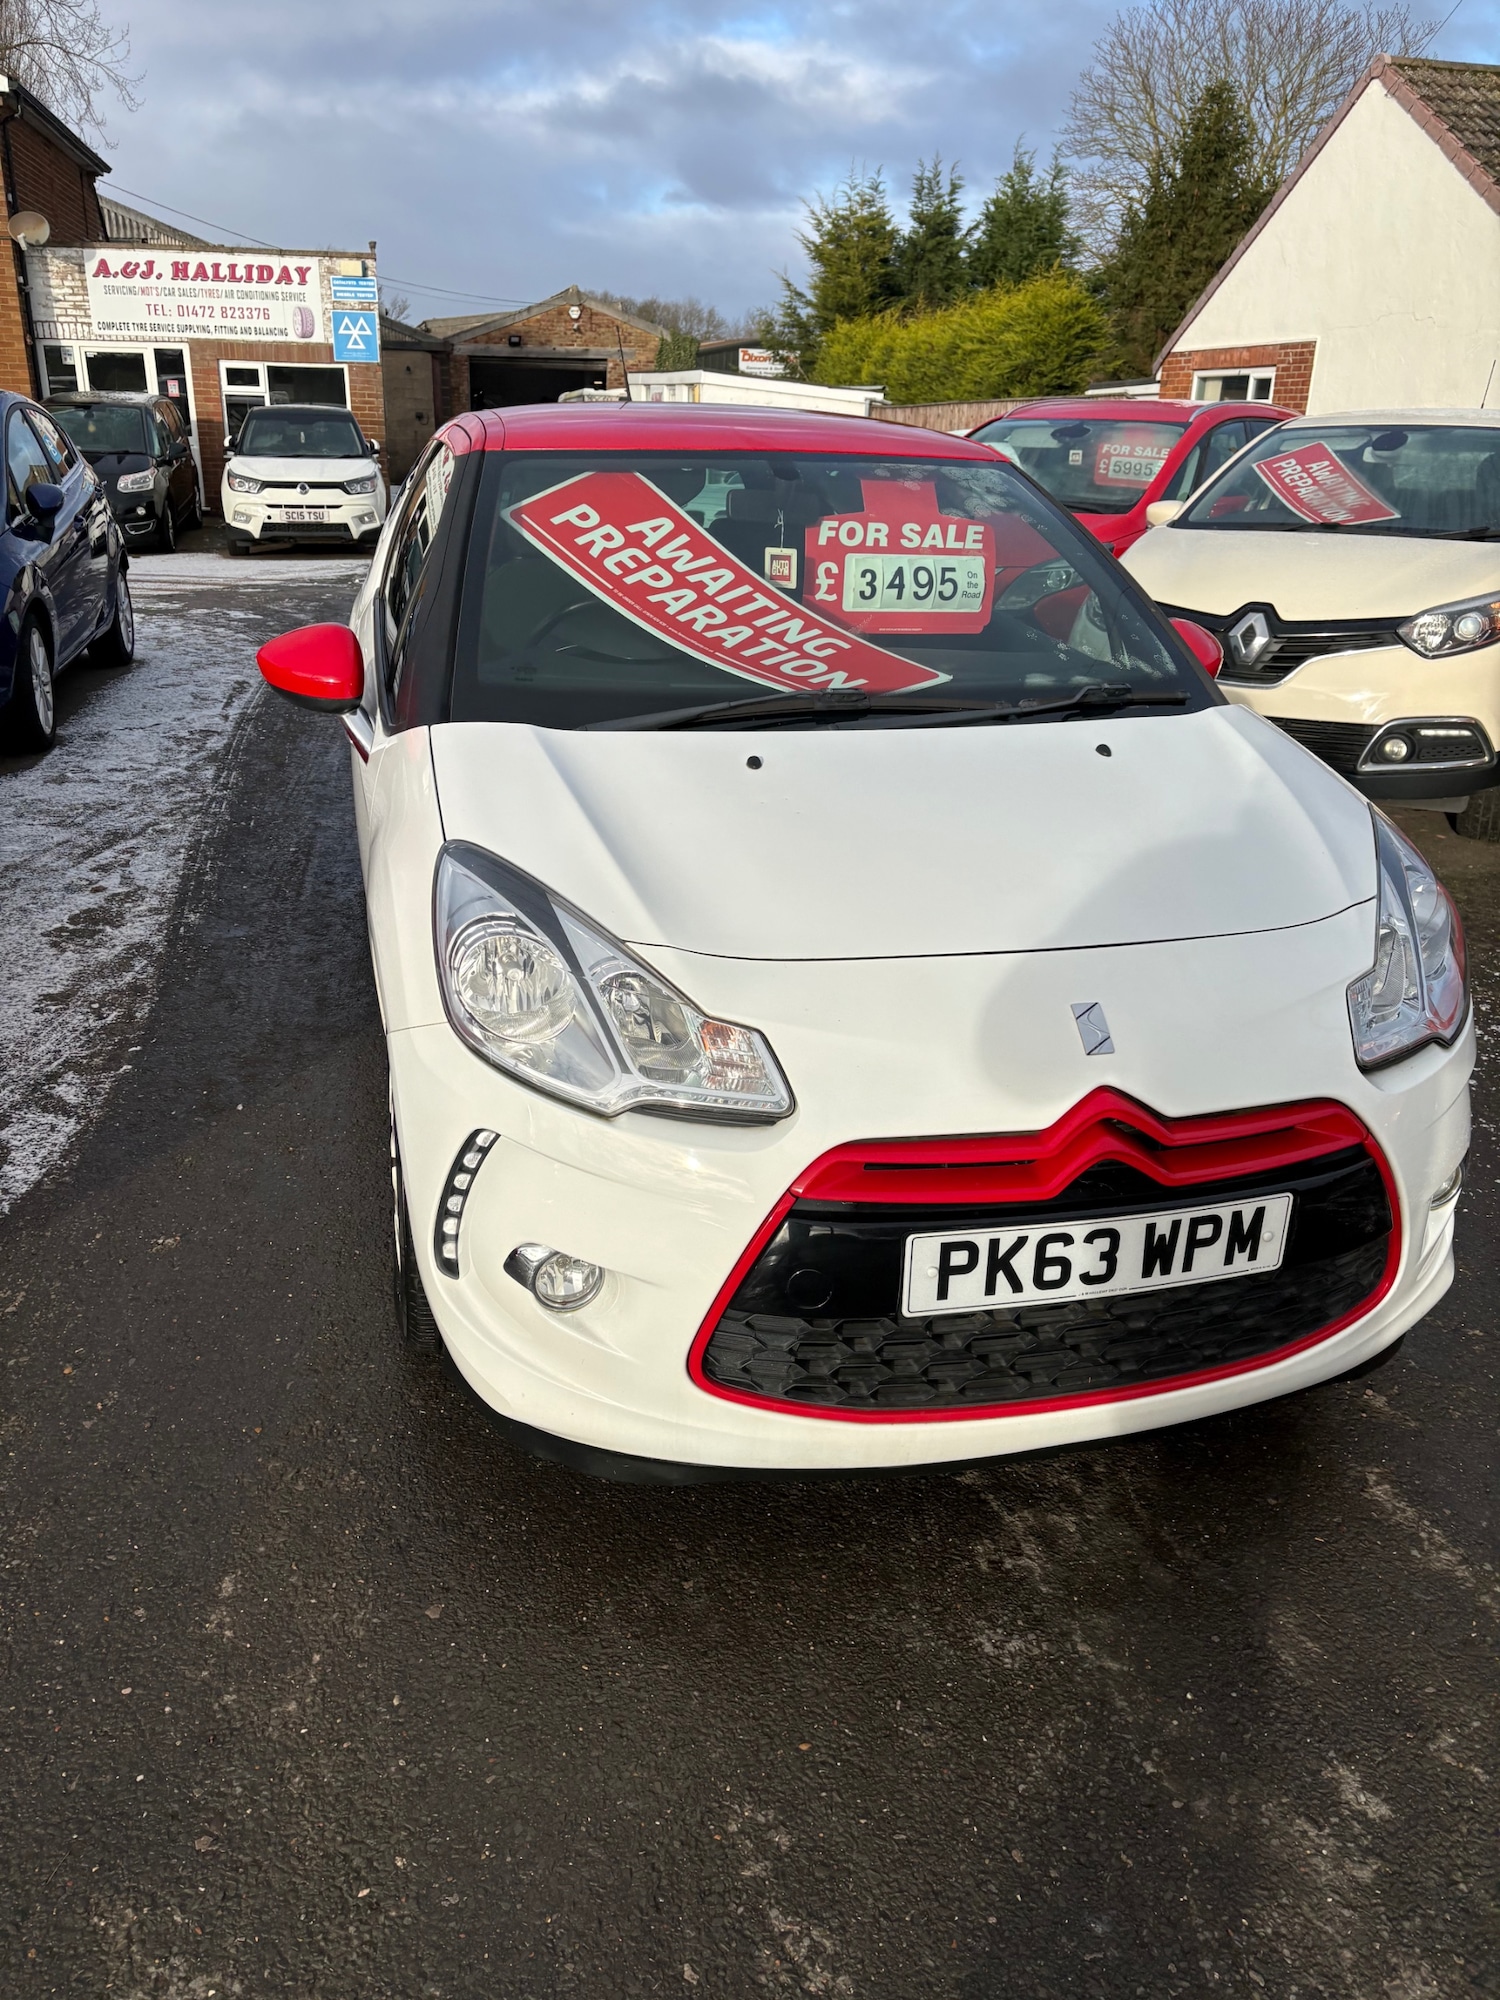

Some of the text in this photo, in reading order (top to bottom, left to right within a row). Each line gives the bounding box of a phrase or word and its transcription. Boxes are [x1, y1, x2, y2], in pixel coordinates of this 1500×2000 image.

[171, 261, 312, 286] HALLIDAY
[236, 290, 280, 301] CONDITIONING
[281, 292, 307, 303] SERVICE
[145, 303, 270, 321] TEL: 01472 823376
[97, 321, 289, 338] COMPLETE TYRE SERVICE SUPPLYING, FITTING AND BALANCING
[1101, 443, 1171, 458] FOR SALE
[1098, 458, 1109, 474] £
[1113, 460, 1154, 477] 5995
[1272, 458, 1355, 521] PREPARATION
[1305, 460, 1371, 508] AWAITING
[284, 511, 325, 520] SC15 TSU
[817, 520, 985, 549] FOR SALE
[772, 560, 790, 568] AUTO
[772, 567, 790, 575] GLYM
[814, 561, 958, 601] £ 3495
[966, 571, 978, 579] On
[624, 516, 852, 658] AWAITING
[967, 580, 979, 589] the
[549, 503, 869, 689] PREPARATION
[961, 590, 981, 599] Road
[936, 1206, 1266, 1301] PK63 WPM
